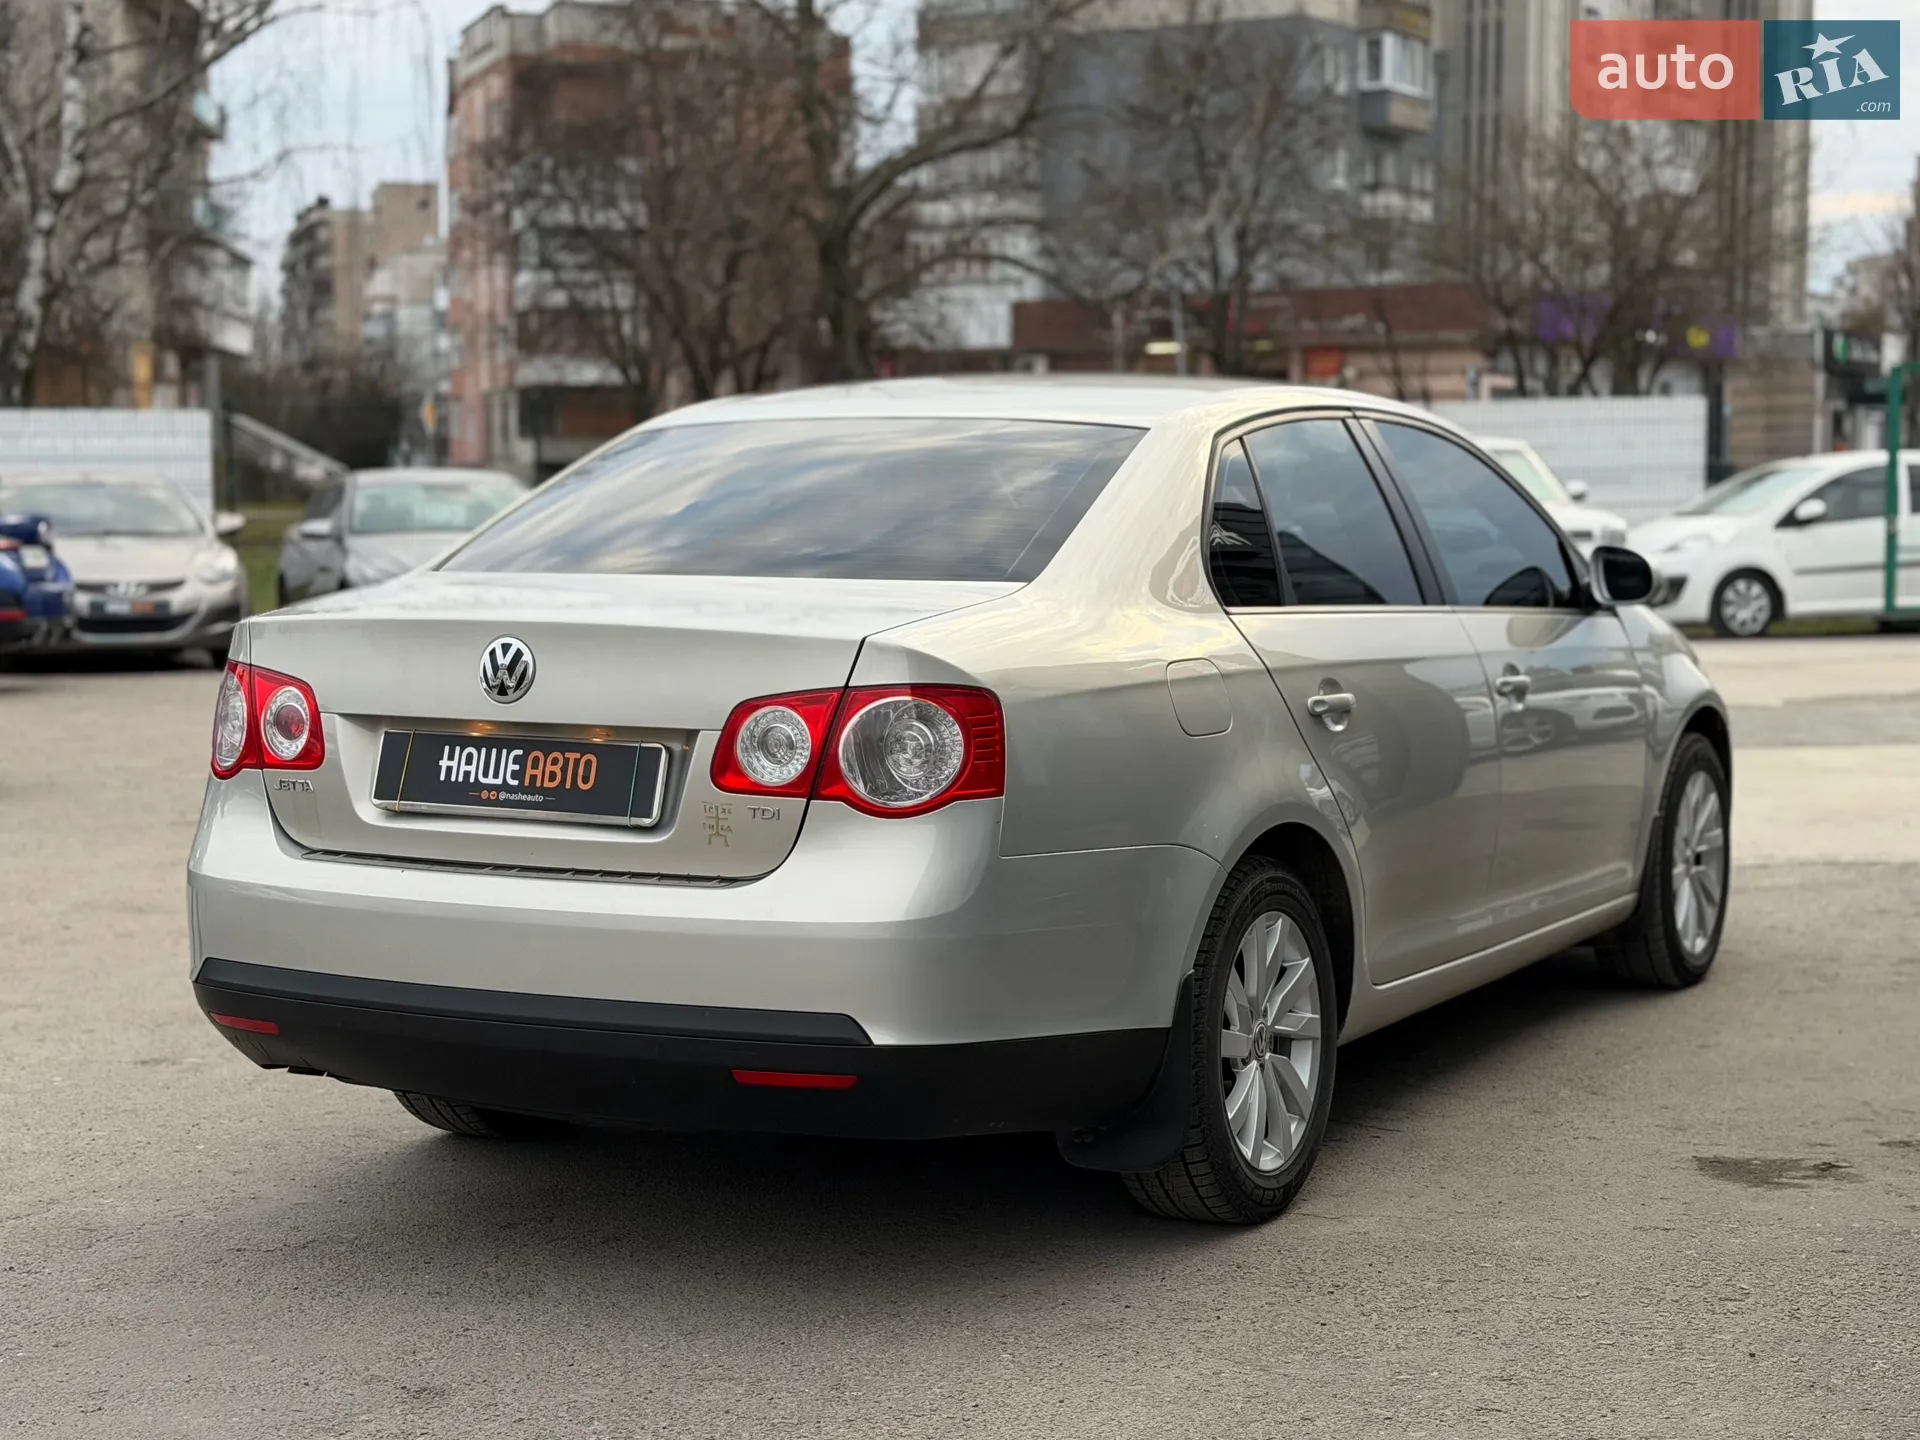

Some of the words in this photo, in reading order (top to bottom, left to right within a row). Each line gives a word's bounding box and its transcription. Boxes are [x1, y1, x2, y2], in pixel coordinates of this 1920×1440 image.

[438, 745, 524, 786] НАШЕ
[524, 750, 598, 791] АВТО
[274, 778, 315, 793] JETTA
[498, 791, 544, 802] @nasheauto
